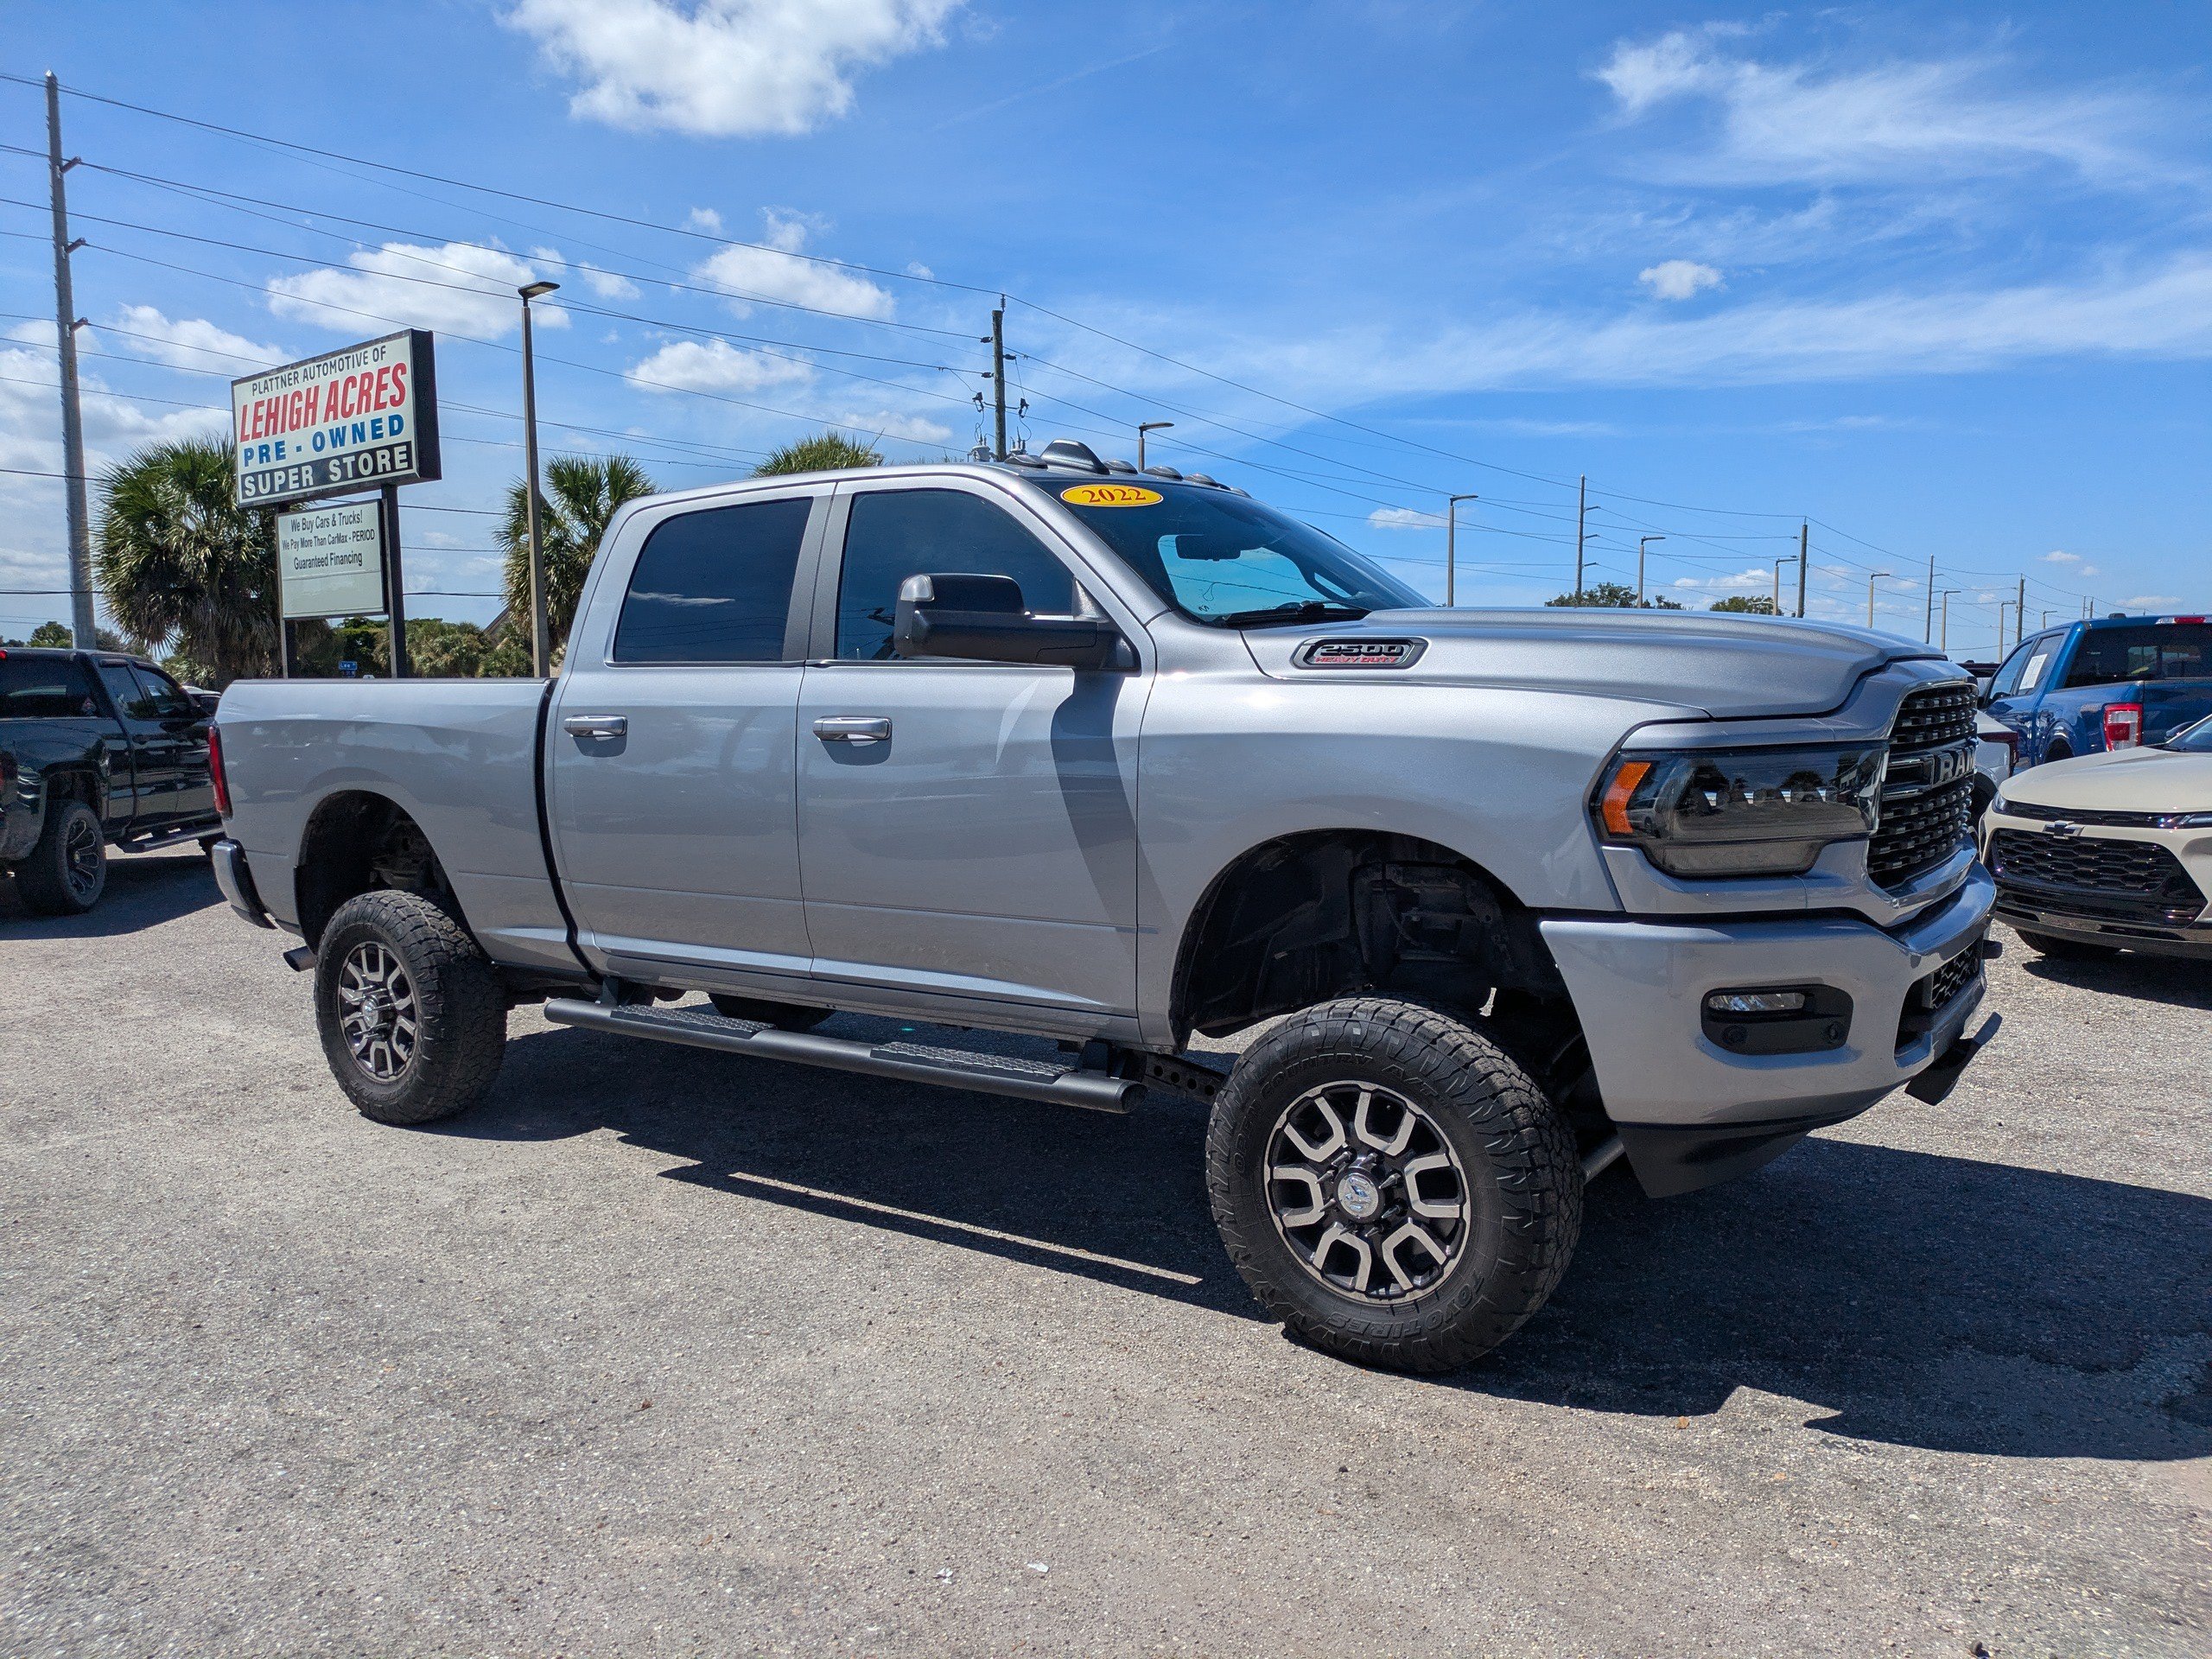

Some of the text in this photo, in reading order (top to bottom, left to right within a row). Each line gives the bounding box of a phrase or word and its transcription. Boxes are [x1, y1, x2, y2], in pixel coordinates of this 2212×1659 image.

[252, 345, 387, 397] PLATTNER AUTOMOTIVE OF
[240, 362, 407, 442] LEHIGH ACRES
[244, 440, 286, 467] PRE
[312, 414, 404, 453] OWNED
[245, 445, 409, 497] SUPER STORE
[1082, 488, 1147, 503] 2022
[291, 510, 363, 533] We Buy Cars & Trucks!
[283, 539, 289, 550] We
[290, 538, 299, 551] Pay
[300, 537, 313, 548] More
[314, 536, 327, 547] Than
[327, 533, 347, 545] CarMax
[352, 529, 375, 543] PERIOD
[294, 550, 363, 570] Guaranteed Financing
[1319, 644, 1405, 657] 2500
[1324, 1310, 1421, 1339] TIRES
